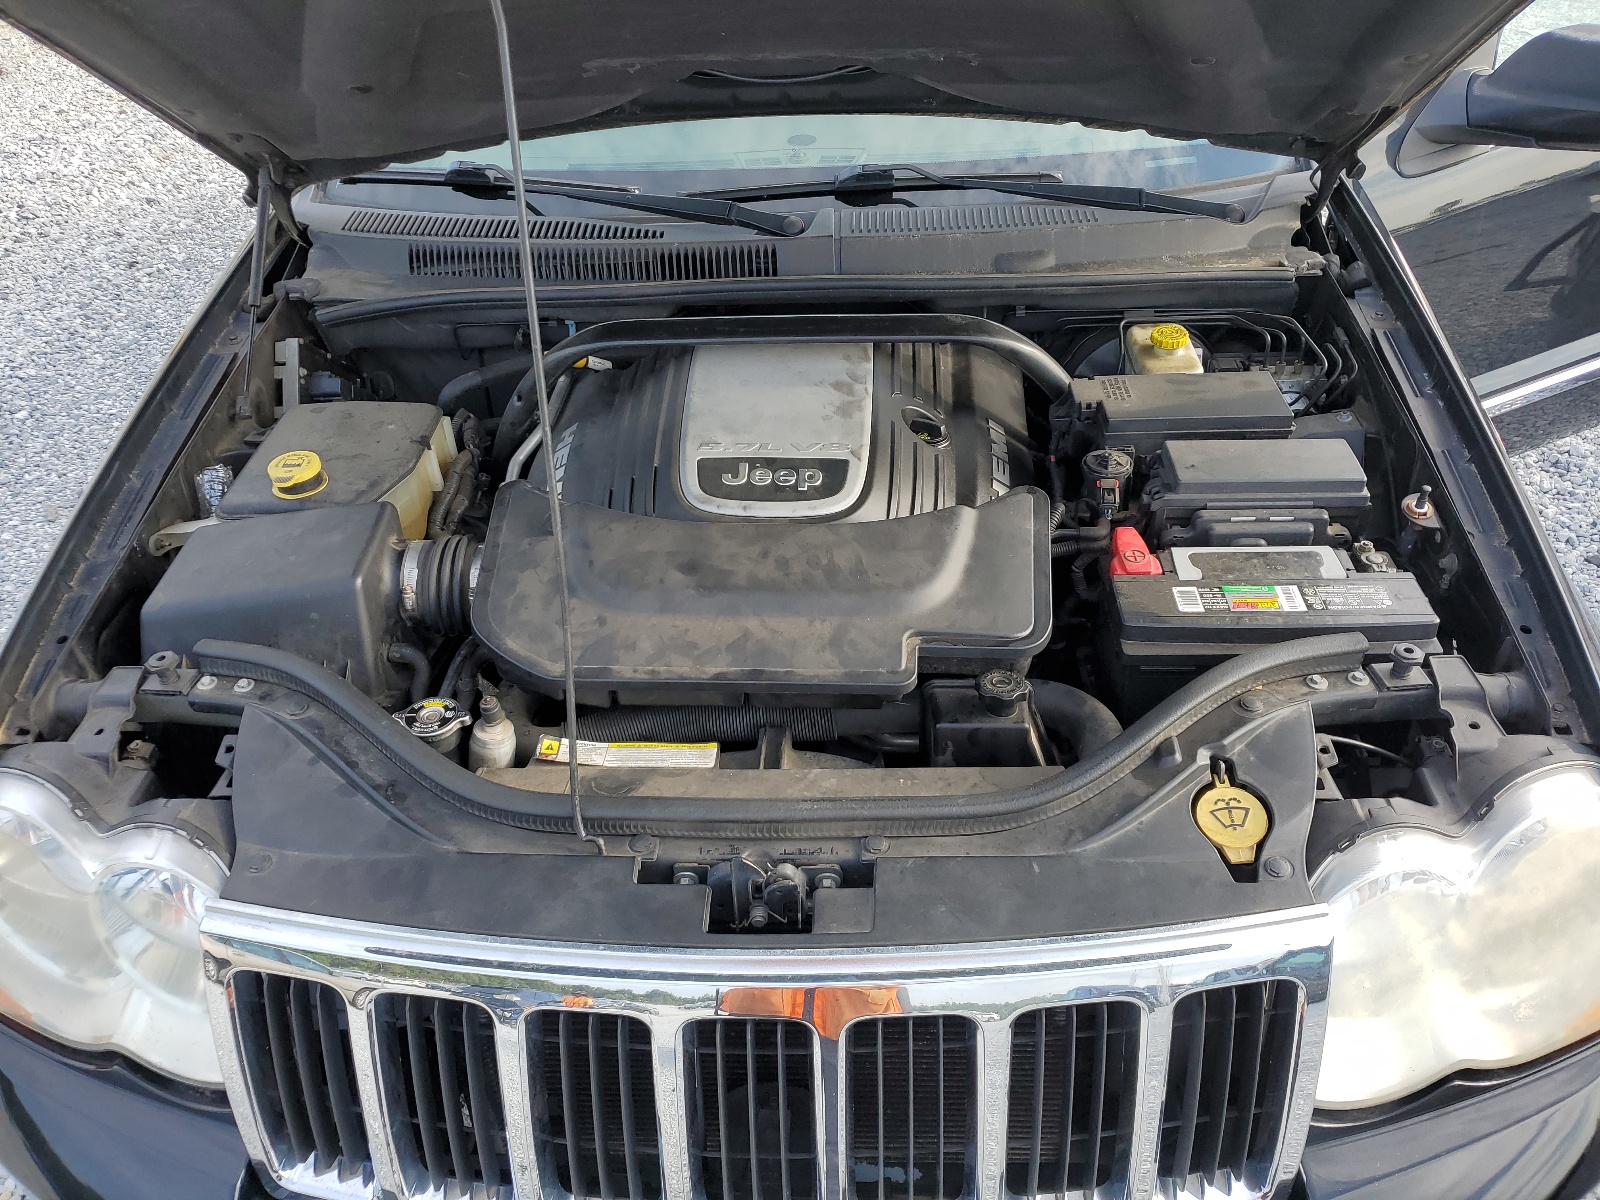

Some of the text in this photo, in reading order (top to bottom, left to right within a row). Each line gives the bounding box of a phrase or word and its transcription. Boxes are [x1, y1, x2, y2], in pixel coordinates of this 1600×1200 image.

[697, 442, 851, 452] 5.7L V8
[722, 462, 823, 490] Jeep
